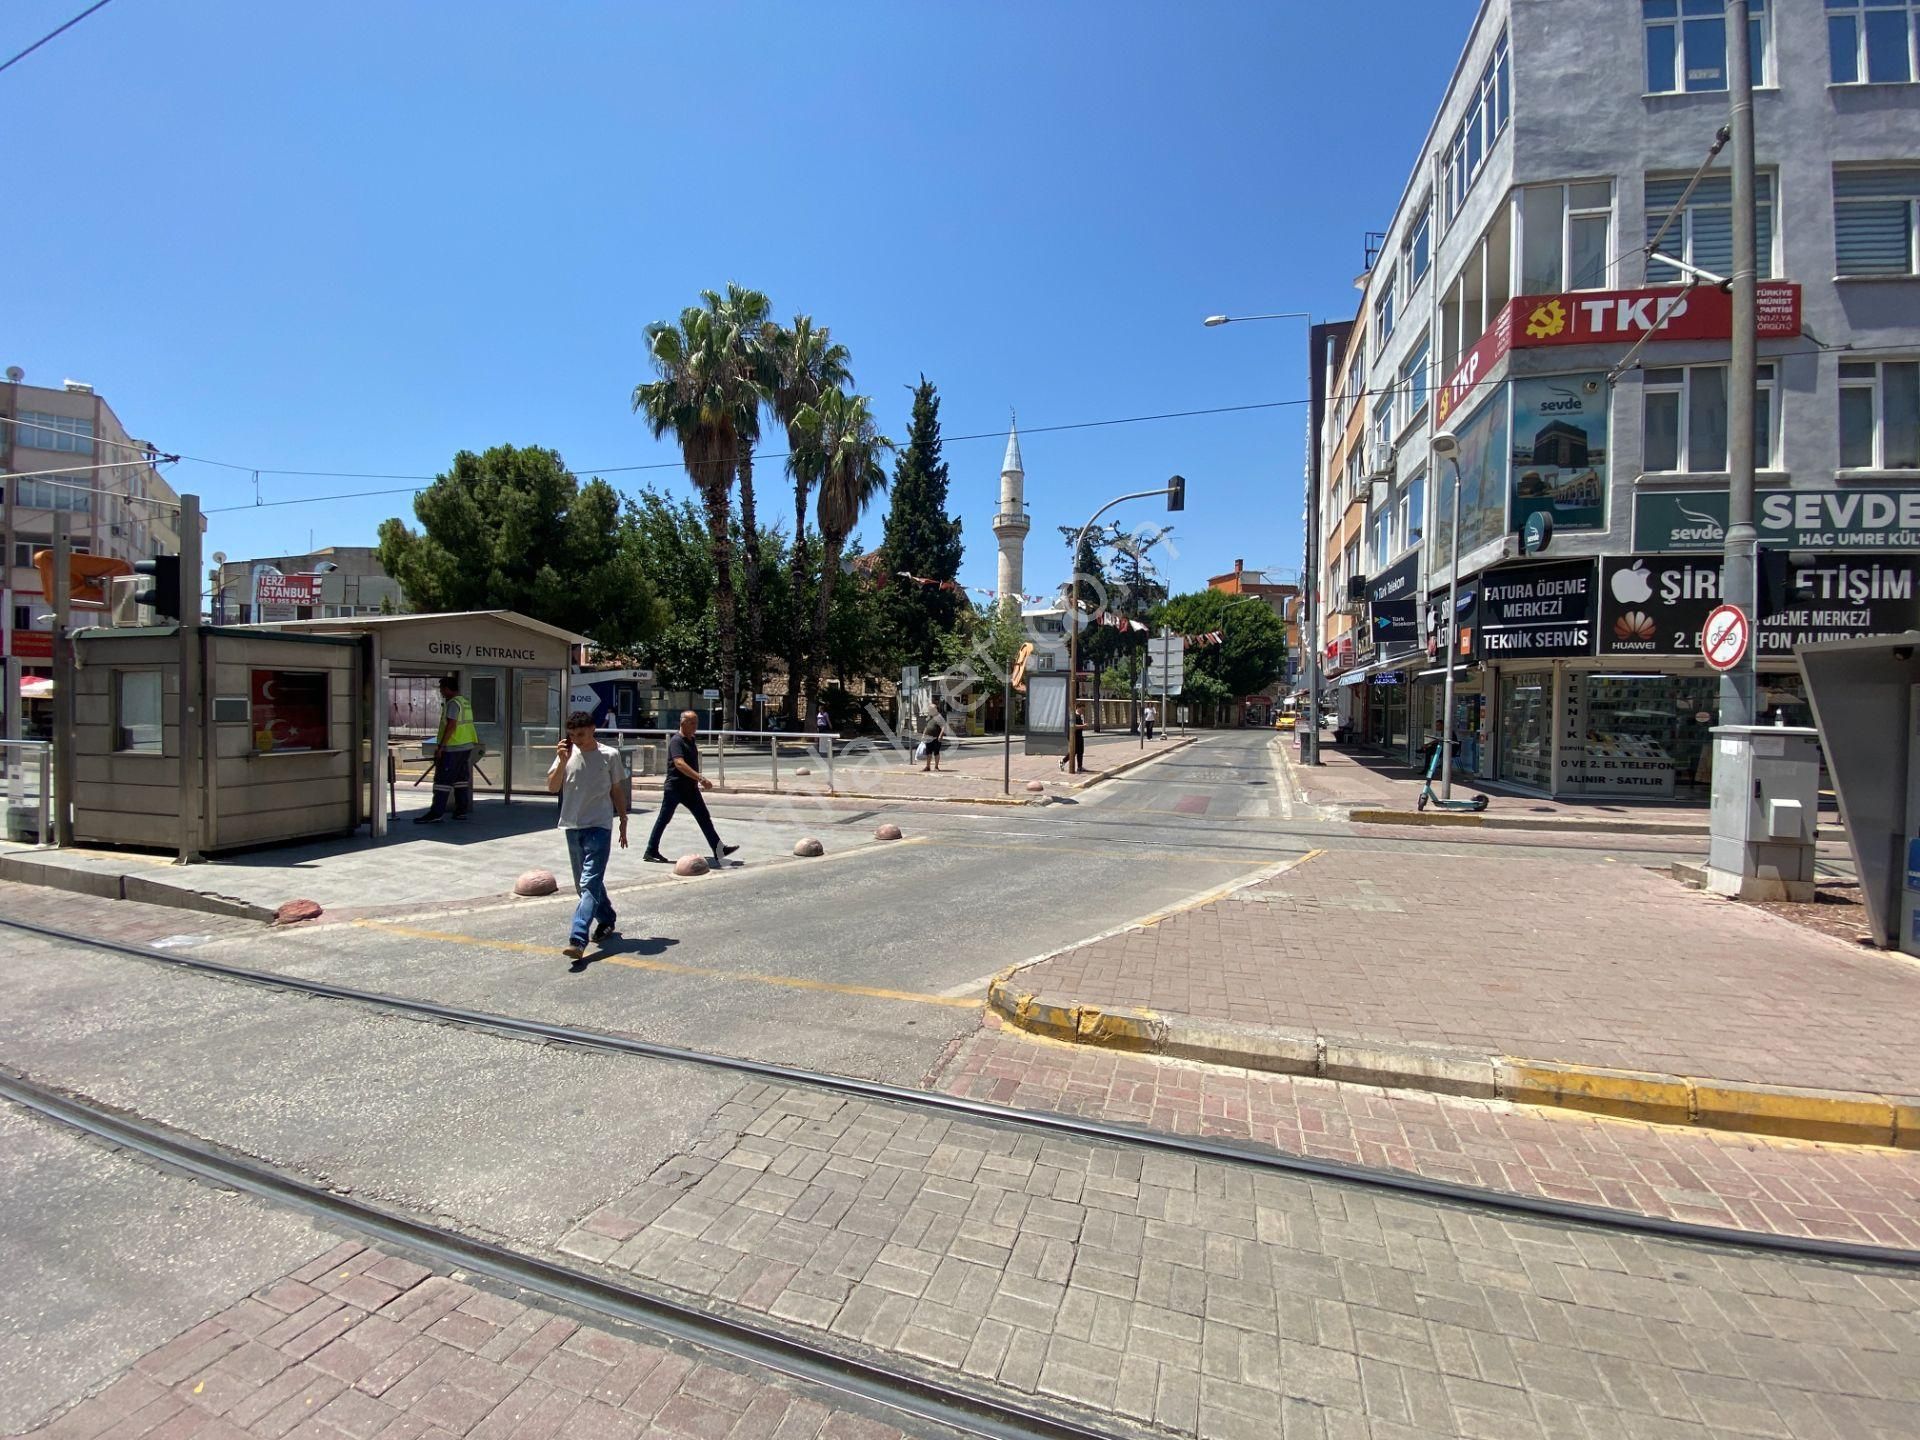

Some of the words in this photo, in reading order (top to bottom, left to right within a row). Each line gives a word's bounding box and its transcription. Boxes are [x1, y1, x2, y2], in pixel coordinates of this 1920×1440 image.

[1757, 297, 1792, 305] MÜNİST
[1581, 297, 1687, 332] TKP
[1452, 351, 1479, 404] TKP
[1540, 397, 1582, 411] sevde
[1761, 494, 1920, 529] SEVDE
[1670, 524, 1724, 540] sevde
[1799, 533, 1834, 545] HAC
[1838, 533, 1885, 545] UMRE
[260, 586, 311, 599] İSTANBUL
[1484, 583, 1534, 601] FATURA
[1536, 578, 1587, 597] ÖDEME
[1660, 565, 1724, 605] ŞİRİ
[1796, 564, 1911, 605] ETİŞİM
[1503, 597, 1562, 618] MERKEZİ
[1811, 608, 1871, 626] MERKEZİ
[1483, 630, 1532, 649] TEKNİK
[1535, 628, 1588, 647] SERVİS
[1673, 632, 1690, 649] 2.
[428, 640, 462, 658] GİRİŞ
[466, 645, 471, 657] /
[475, 646, 535, 660] ENTRANCE
[1571, 760, 1587, 768] VE
[1590, 760, 1600, 769] 2.
[1604, 761, 1618, 769] EL
[1620, 761, 1675, 770] TELEFON
[1565, 775, 1606, 784] ALINIR
[1616, 776, 1664, 786] SATILIR
